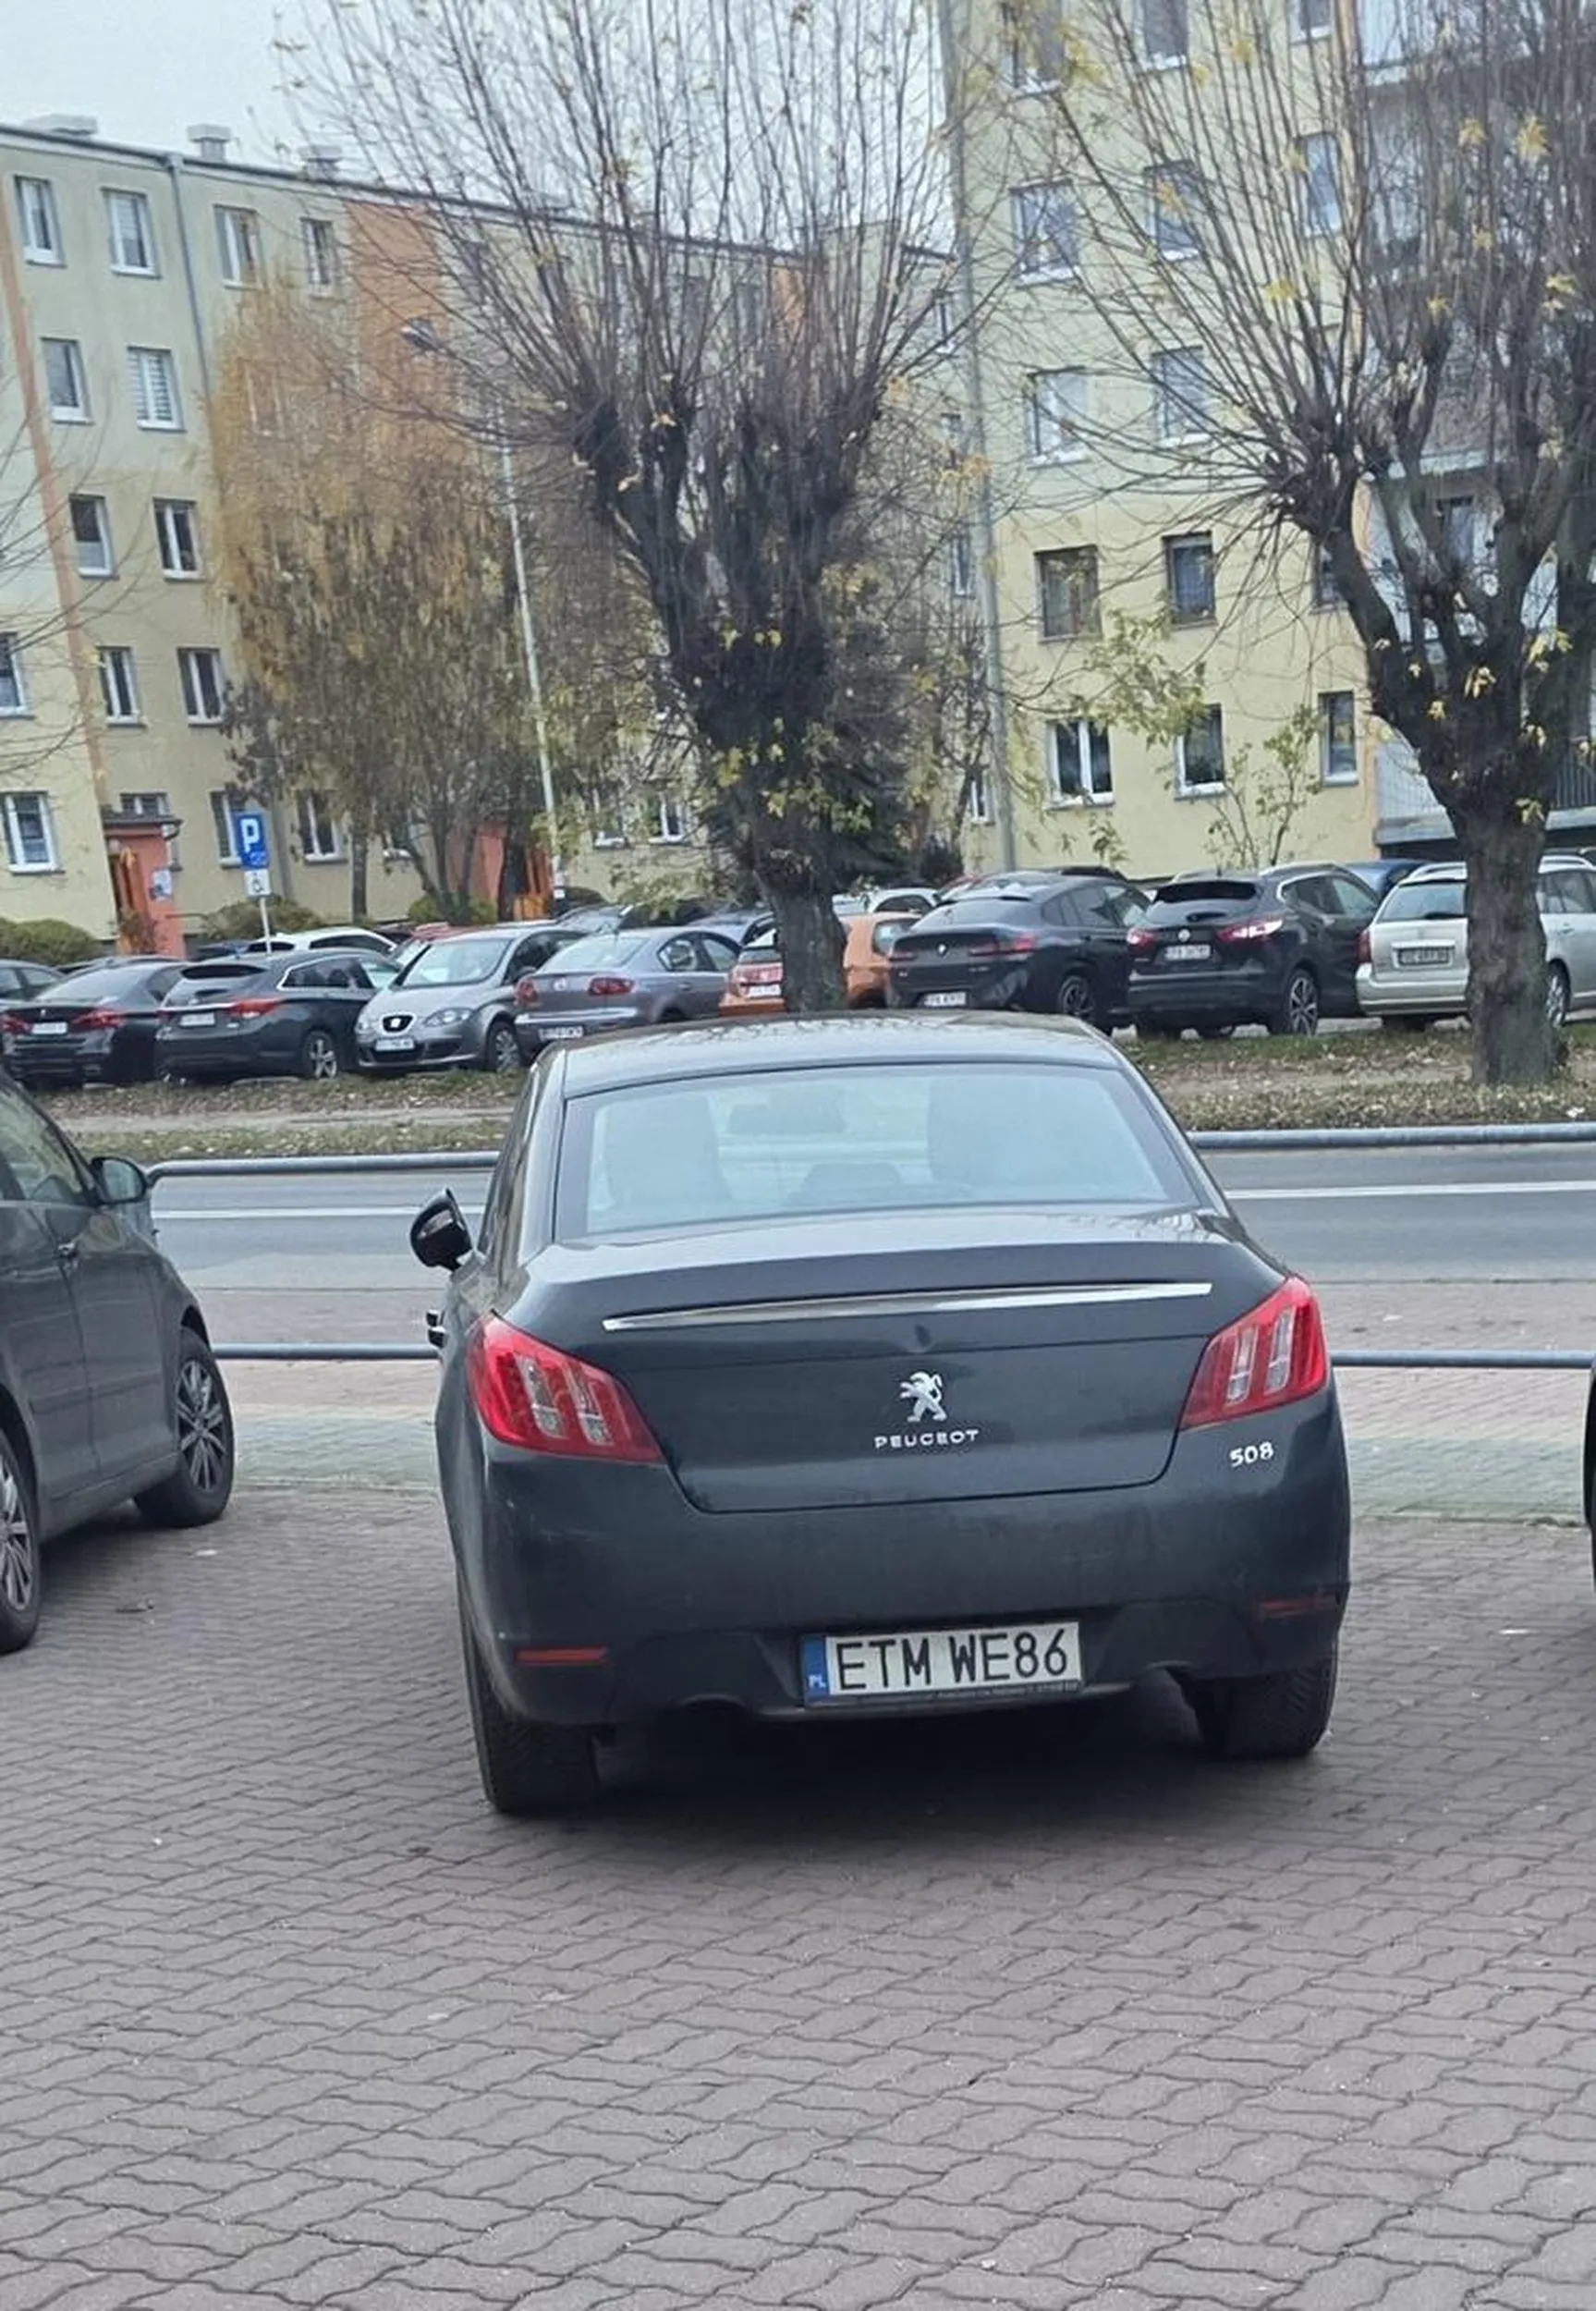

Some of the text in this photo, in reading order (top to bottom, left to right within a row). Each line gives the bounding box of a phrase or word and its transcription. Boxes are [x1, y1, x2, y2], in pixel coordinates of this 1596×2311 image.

[239, 817, 260, 852] P
[873, 1428, 980, 1449] PEUGEOT
[1229, 1441, 1274, 1467] 508
[835, 1628, 1067, 1691] ETM WE86
